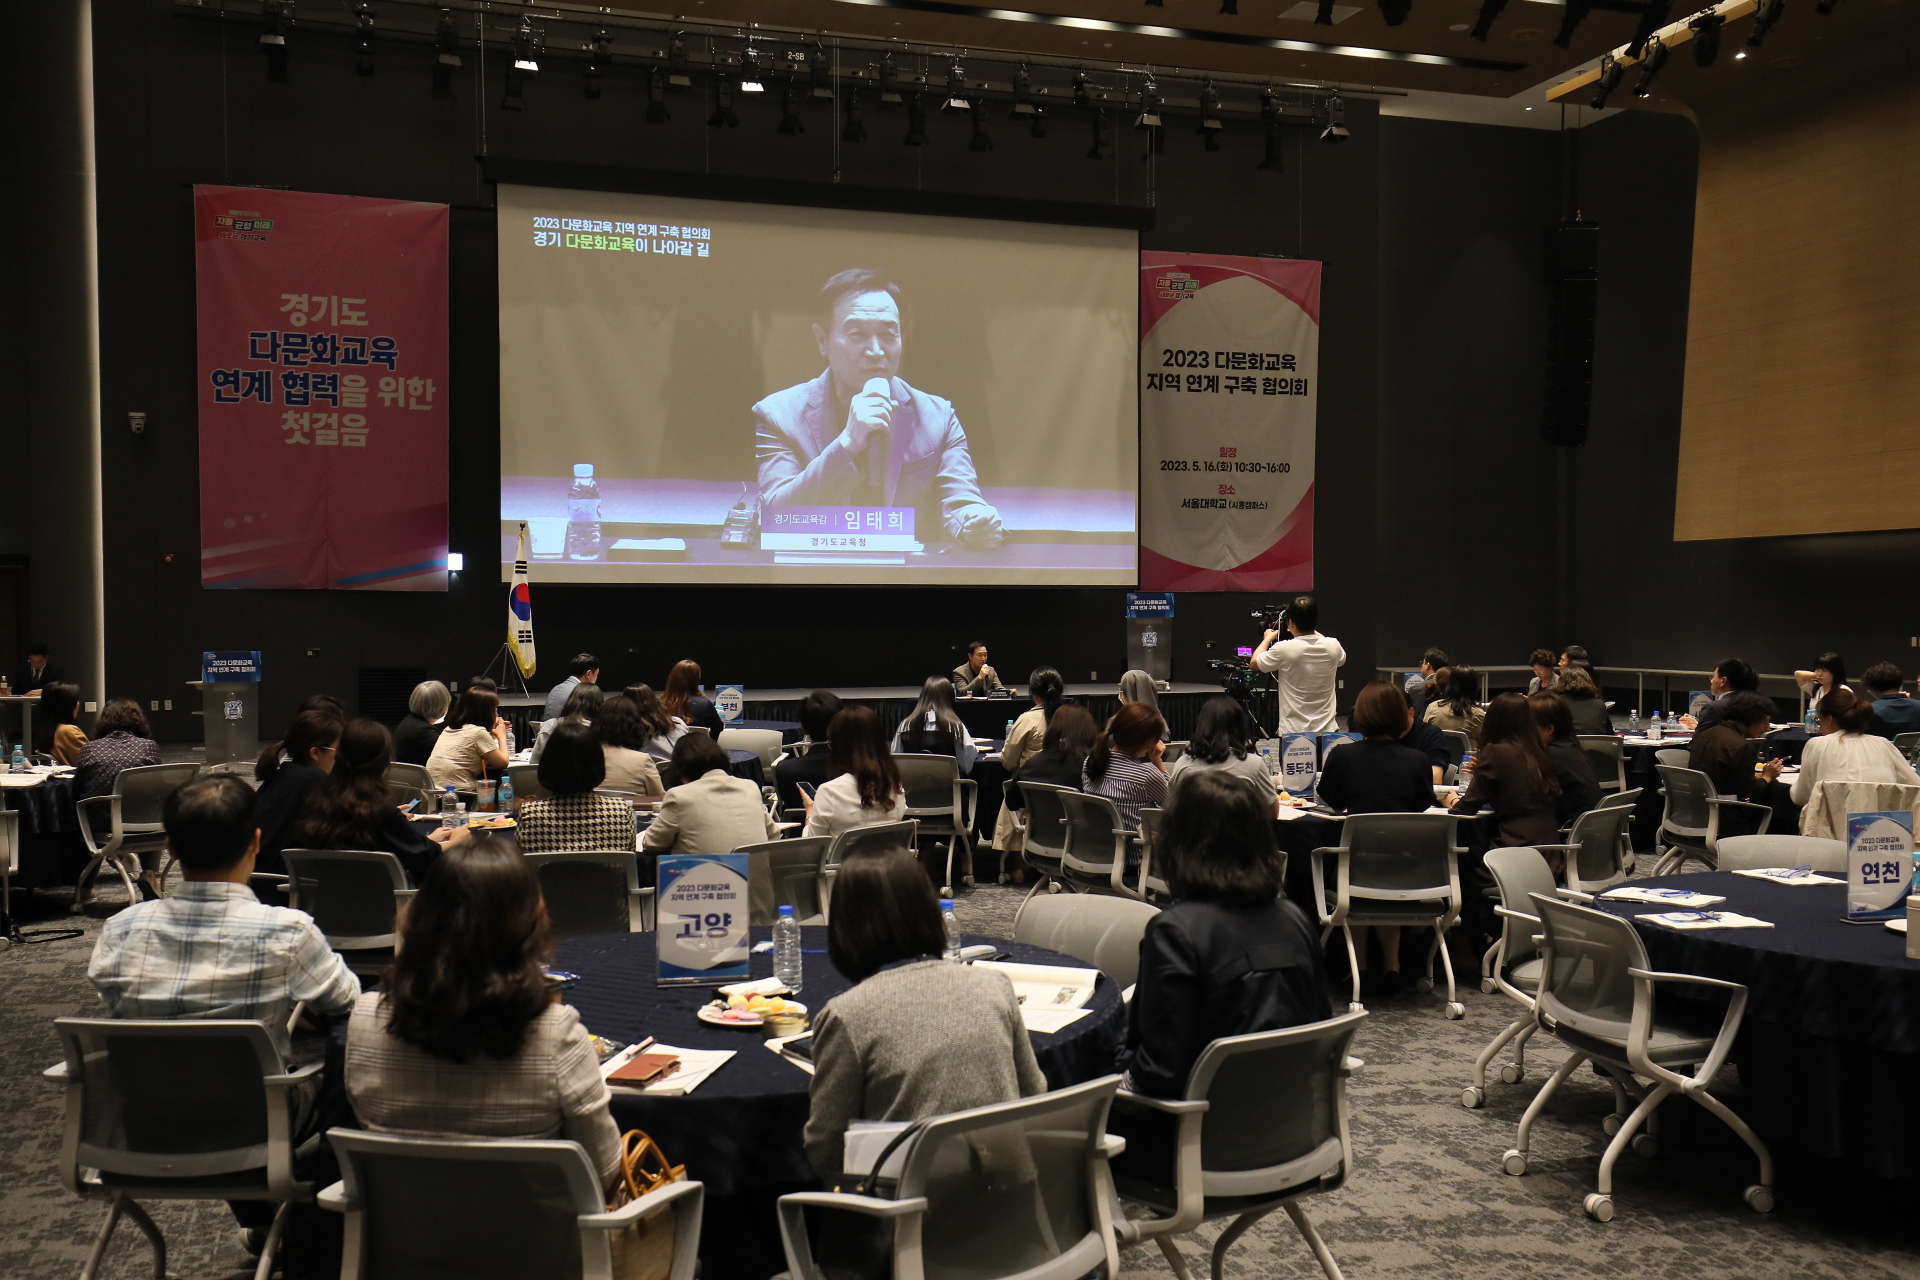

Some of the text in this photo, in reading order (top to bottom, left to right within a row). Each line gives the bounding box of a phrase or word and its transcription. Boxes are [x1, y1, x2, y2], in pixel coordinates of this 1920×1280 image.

[787, 51, 805, 61] 2-SB
[533, 216, 711, 240] 2023 다문화교육 지역 연계 구축 협의회
[533, 231, 710, 257] 경기 다문화교육이 나아갈 길
[280, 293, 369, 327] 경기도
[248, 331, 399, 371] 다문화교육
[1162, 348, 1296, 372] 2023 다문화교육
[211, 369, 436, 411] 연계 협력을 위한
[1146, 373, 1308, 396] 지역 연계 구축 협의회
[281, 410, 369, 447] 첫걸음
[1219, 446, 1237, 458] 일정
[1160, 460, 1290, 473] 2023. 5. 16.(화) 10:30~16:00
[1218, 484, 1236, 495] 장소
[1181, 498, 1268, 510] 서울대학교 (시흥캠퍼스)
[774, 510, 903, 531] 경기도교육감 임태희
[811, 537, 866, 547] 경기도교육청
[1286, 761, 1314, 776] 동두천
[1861, 861, 1900, 885] 연천
[671, 893, 684, 901] 지역
[676, 883, 730, 892] 2023 다문화교육
[676, 912, 732, 939] 고양
